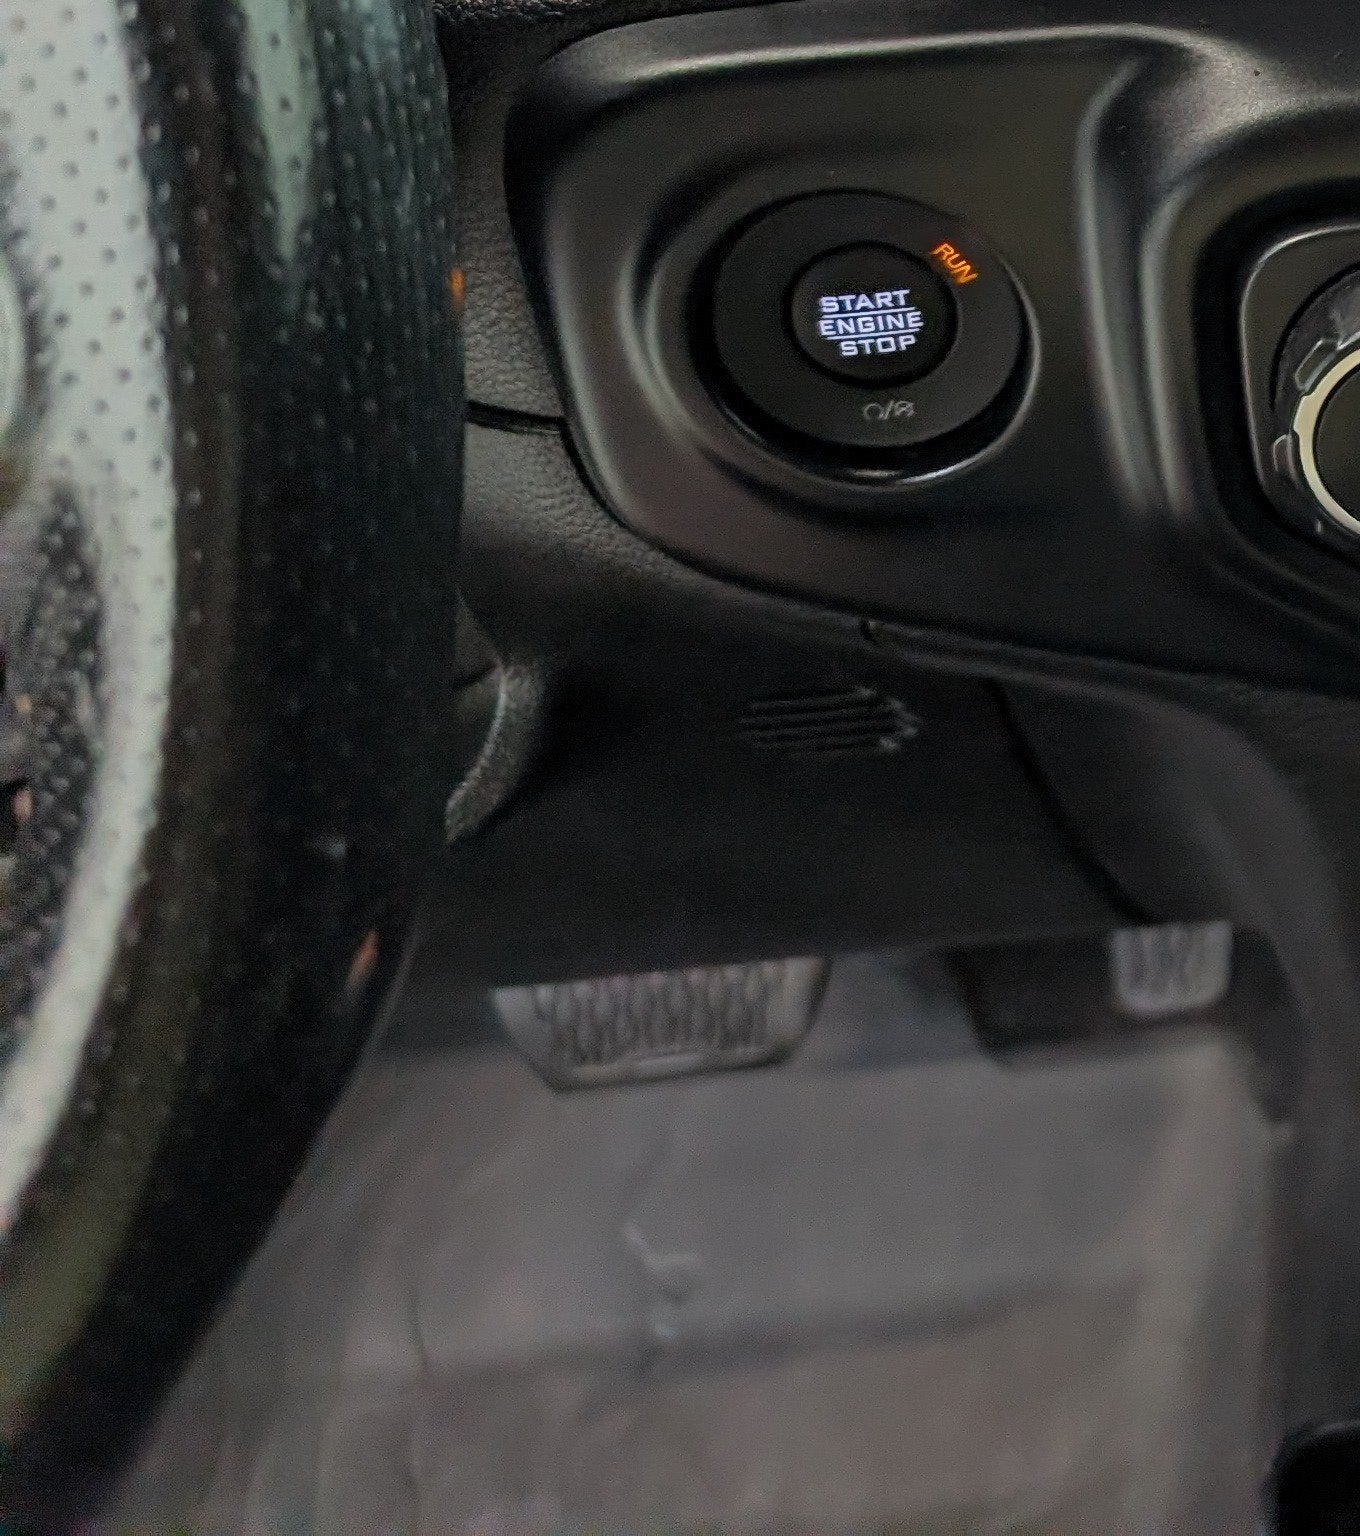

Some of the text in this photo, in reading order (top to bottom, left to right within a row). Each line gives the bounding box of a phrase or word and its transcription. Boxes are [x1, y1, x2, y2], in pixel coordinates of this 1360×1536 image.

[932, 242, 978, 285] RUN
[819, 289, 910, 313] START
[819, 311, 924, 336] ENGINE
[840, 335, 916, 356] STOP
